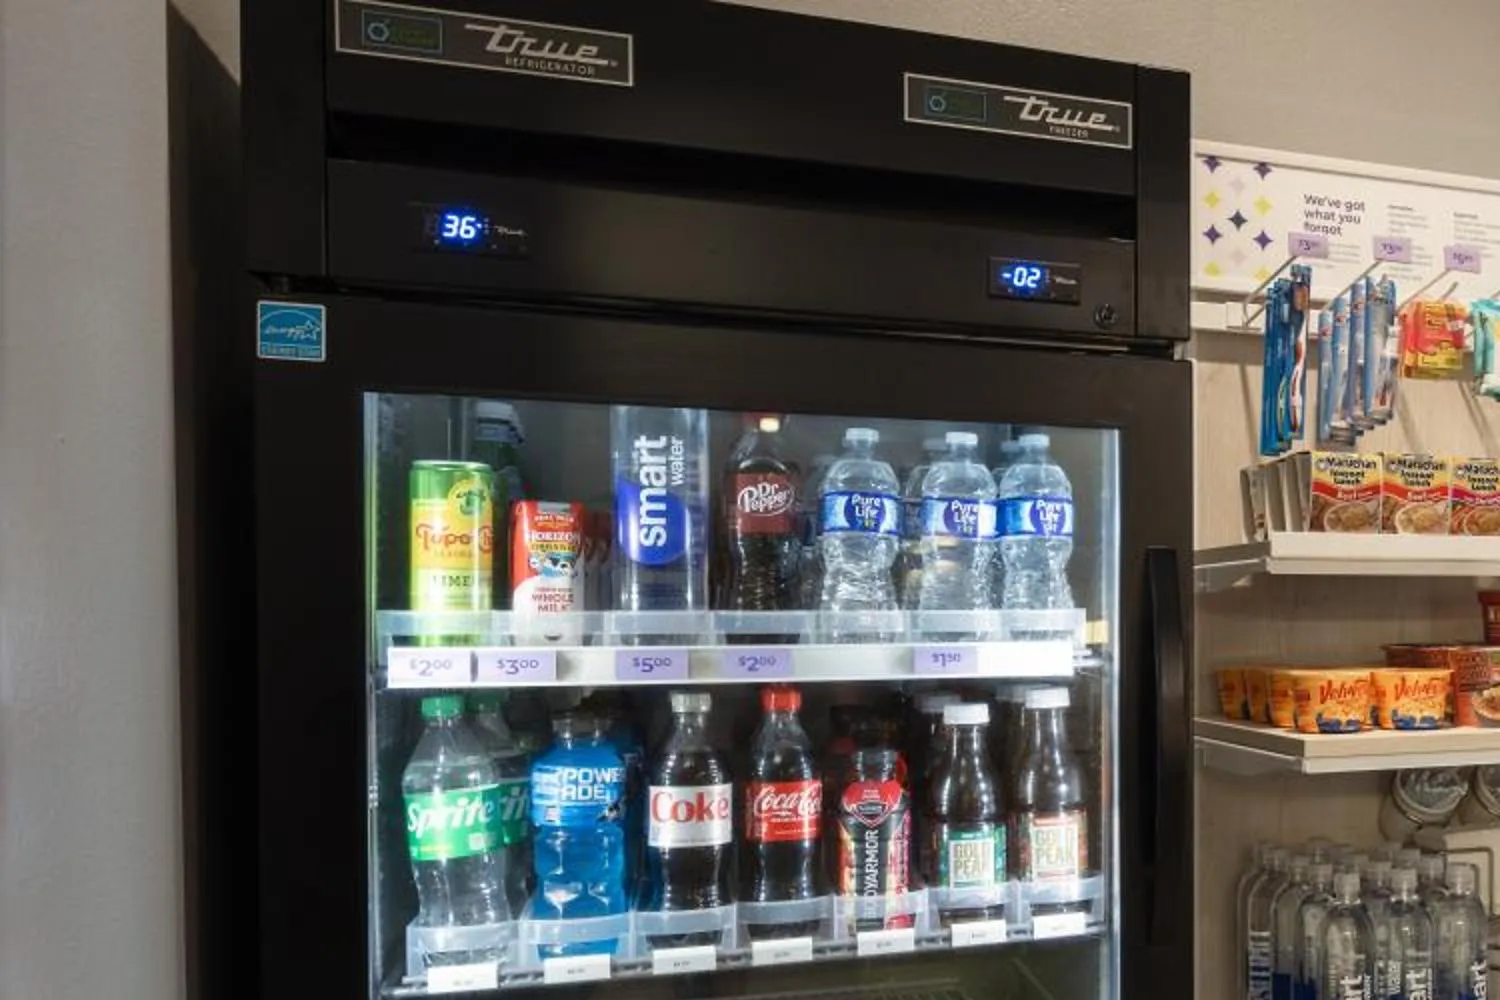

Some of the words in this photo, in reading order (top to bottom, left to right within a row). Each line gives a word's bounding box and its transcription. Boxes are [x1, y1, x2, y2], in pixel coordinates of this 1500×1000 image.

[504, 56, 596, 77] REFRIGERATOR
[1049, 126, 1089, 138] FREEZER
[1304, 194, 1341, 208] We've
[1344, 200, 1365, 212] got
[1304, 209, 1336, 221] what
[1339, 214, 1361, 225] you
[1304, 221, 1343, 237] forgot
[670, 435, 686, 486] water
[634, 434, 669, 547] smart
[757, 482, 779, 499] Dr
[742, 487, 793, 513] Pepper
[851, 493, 882, 508] Pure
[951, 499, 980, 514] Pure
[1035, 499, 1063, 513] Pure
[855, 505, 879, 519] Life
[954, 511, 979, 526] Life
[532, 592, 576, 604] WHOLE
[537, 603, 569, 614] MILK
[652, 791, 730, 824] Coke
[406, 796, 496, 838] Sprite
